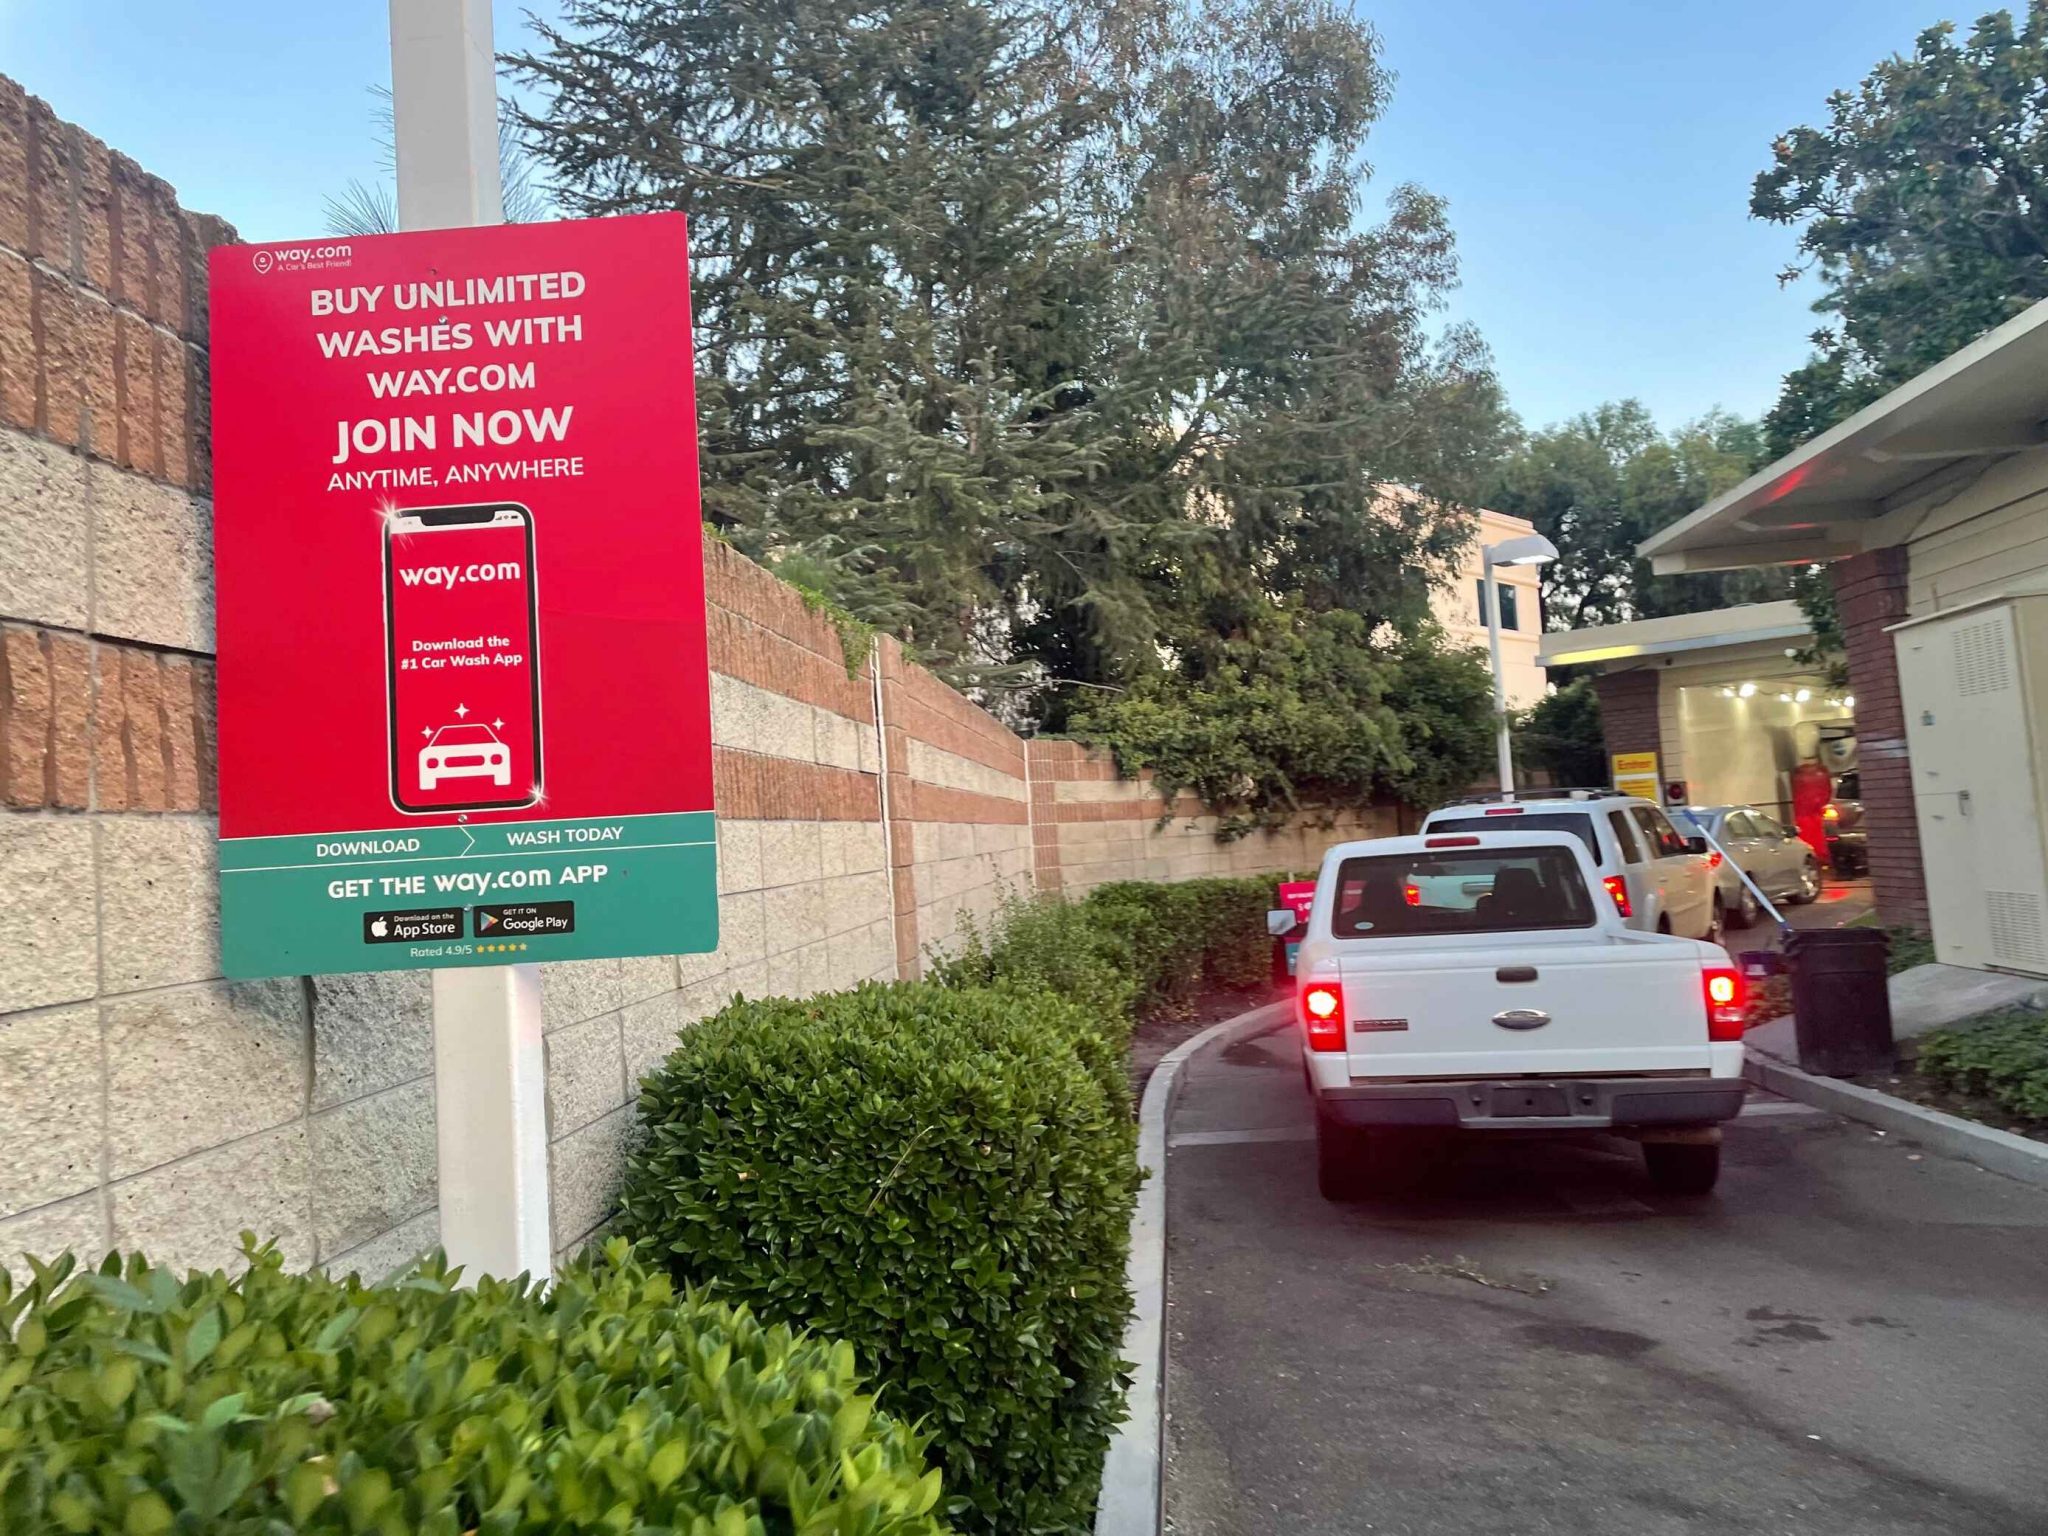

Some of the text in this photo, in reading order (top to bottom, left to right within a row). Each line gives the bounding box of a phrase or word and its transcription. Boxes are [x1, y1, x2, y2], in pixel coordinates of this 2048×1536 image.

[275, 246, 352, 263] way.com
[307, 261, 324, 270] Best
[310, 271, 586, 317] BUY UNLIMITED
[316, 314, 583, 359] WASHES WITH
[367, 361, 536, 399] WAY.COM
[332, 405, 574, 464] JOIN NOW
[327, 457, 585, 492] ANYTIME, ANYWHERE
[399, 561, 521, 590] way.com
[412, 635, 510, 652] Download the
[401, 653, 523, 670] #1 Car Wash App
[506, 826, 624, 846] WASH TODAY
[316, 838, 420, 858] DOWNLOAD
[328, 864, 608, 899] GET THE way.com APP
[394, 914, 430, 923] Download
[442, 912, 454, 920] the
[503, 908, 516, 916] GET
[525, 907, 537, 915] ON
[394, 922, 456, 938] App Store
[503, 917, 568, 932] Google Play
[410, 944, 473, 958] Rated 4.9/5
